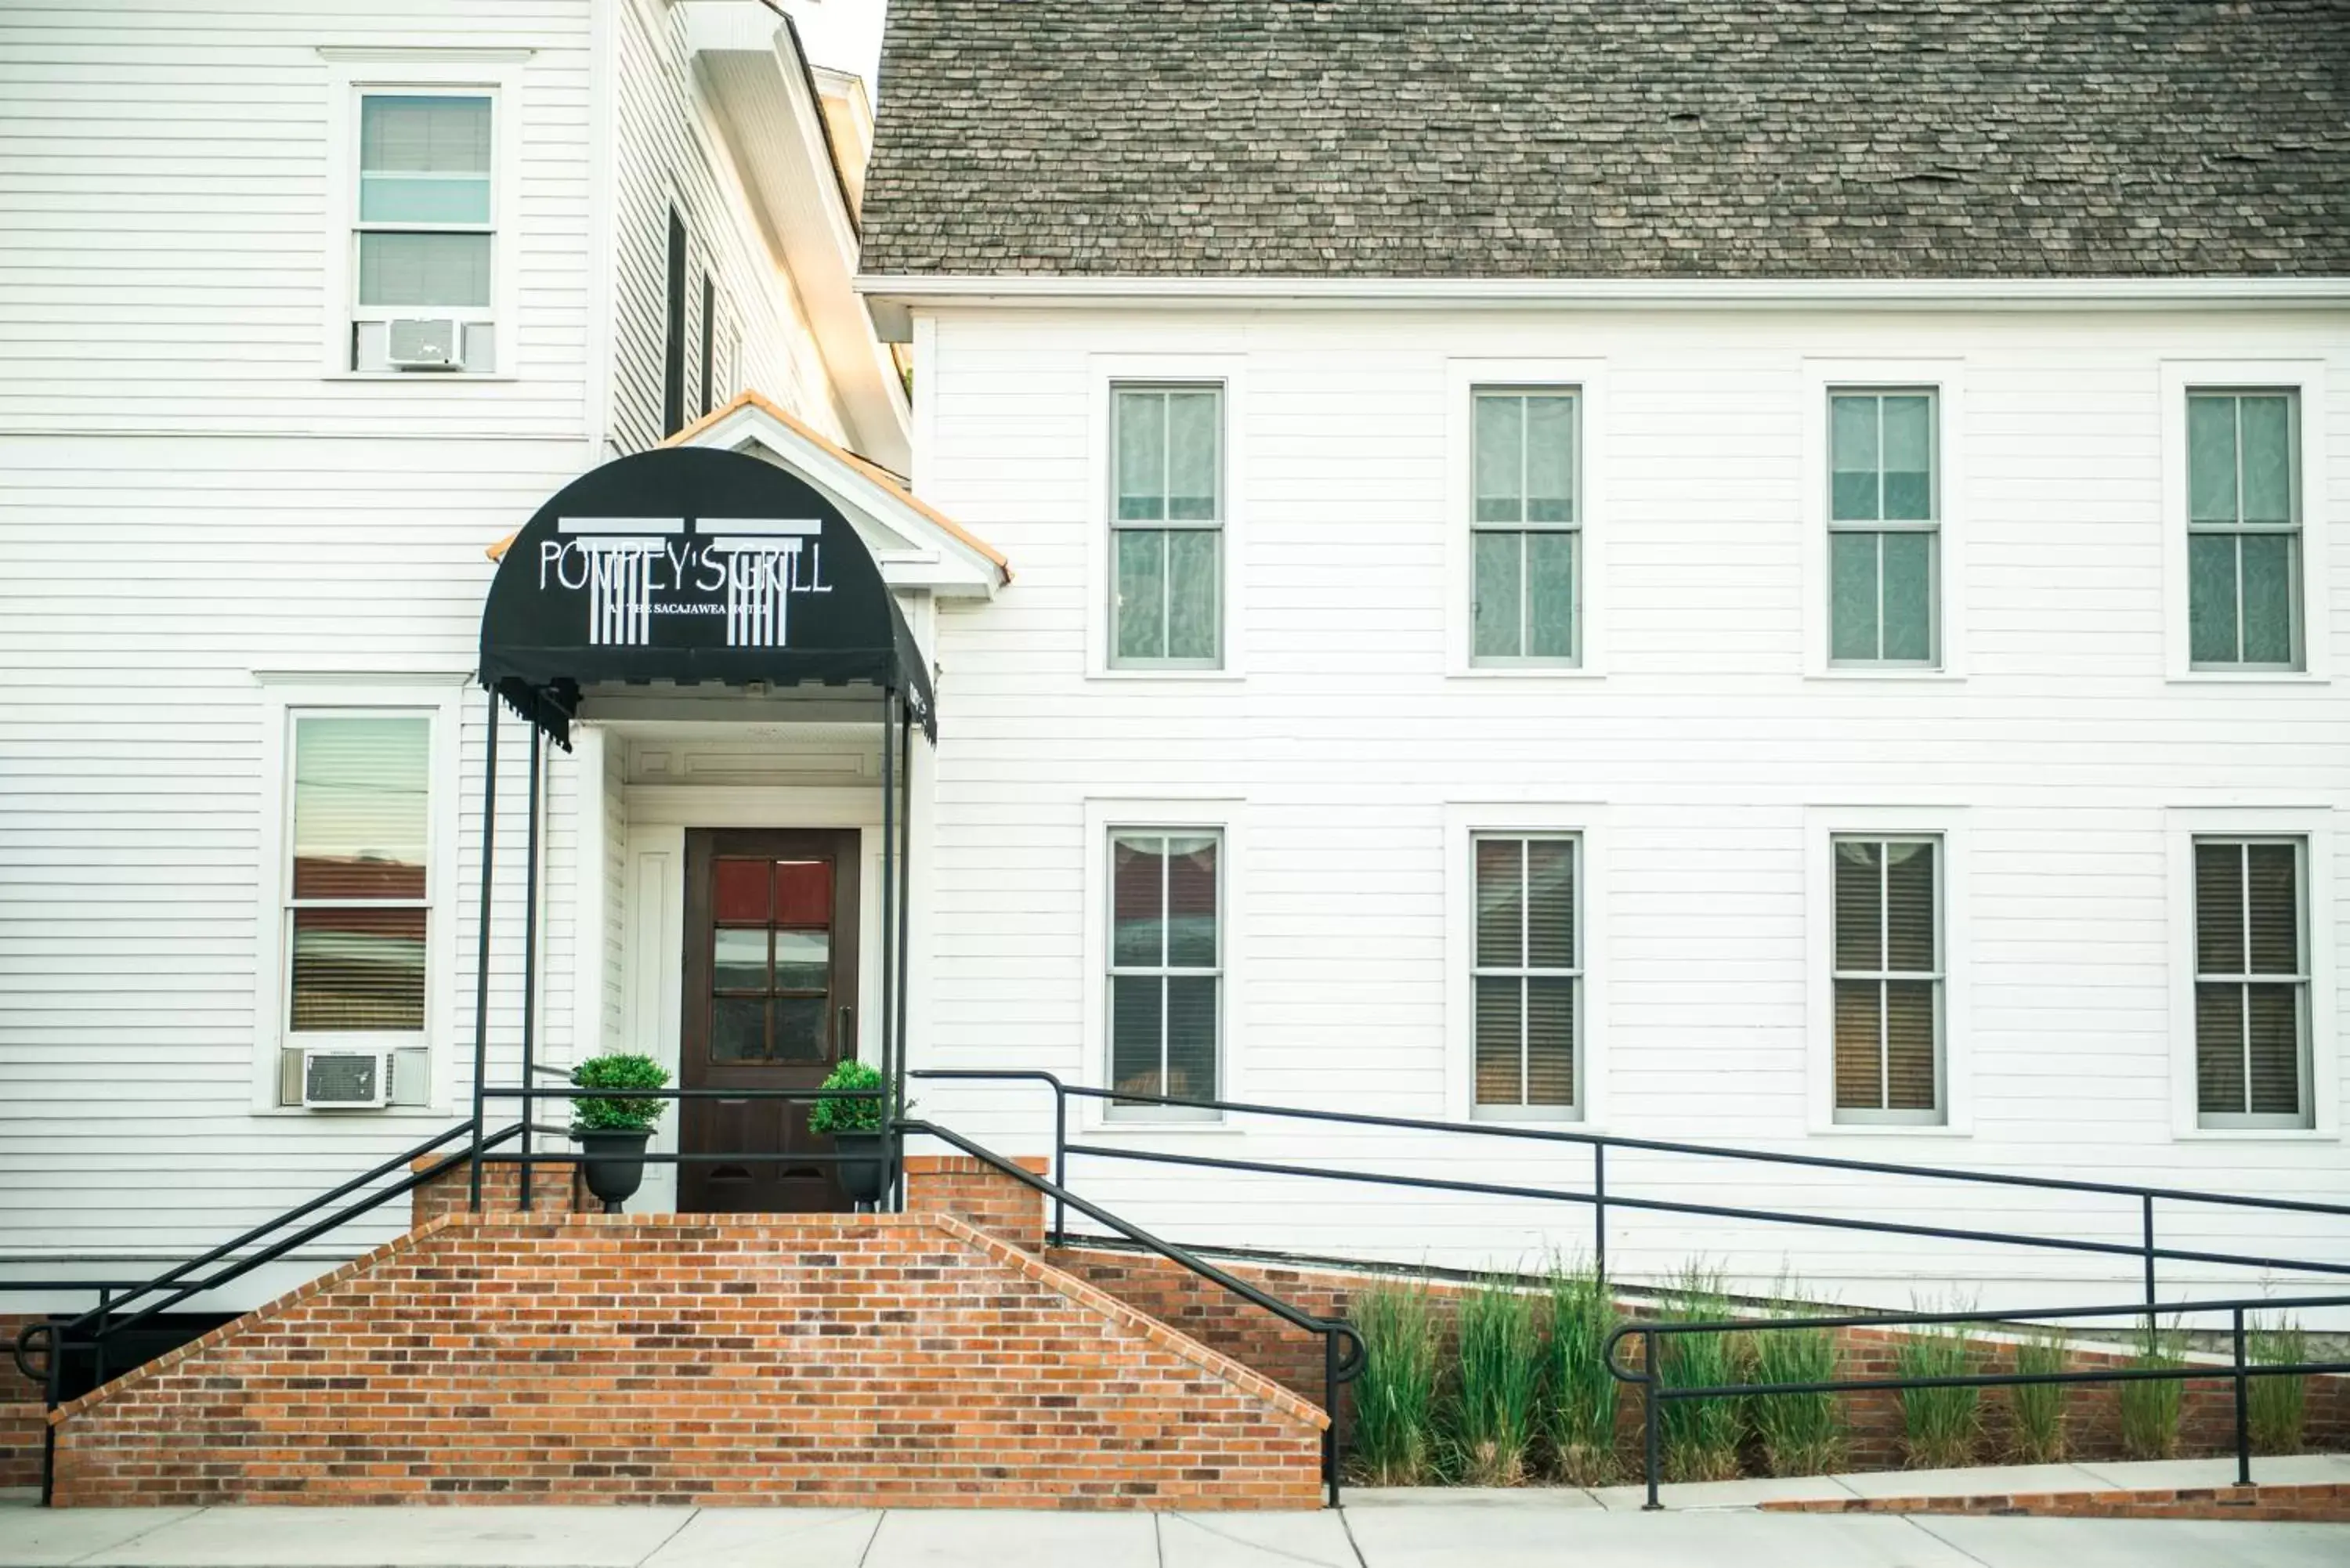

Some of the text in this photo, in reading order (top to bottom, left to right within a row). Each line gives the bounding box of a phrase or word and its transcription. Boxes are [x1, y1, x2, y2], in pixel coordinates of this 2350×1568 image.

[540, 540, 833, 592] POMPEY'S GRILL
[653, 603, 727, 615] SACAJAWEA
